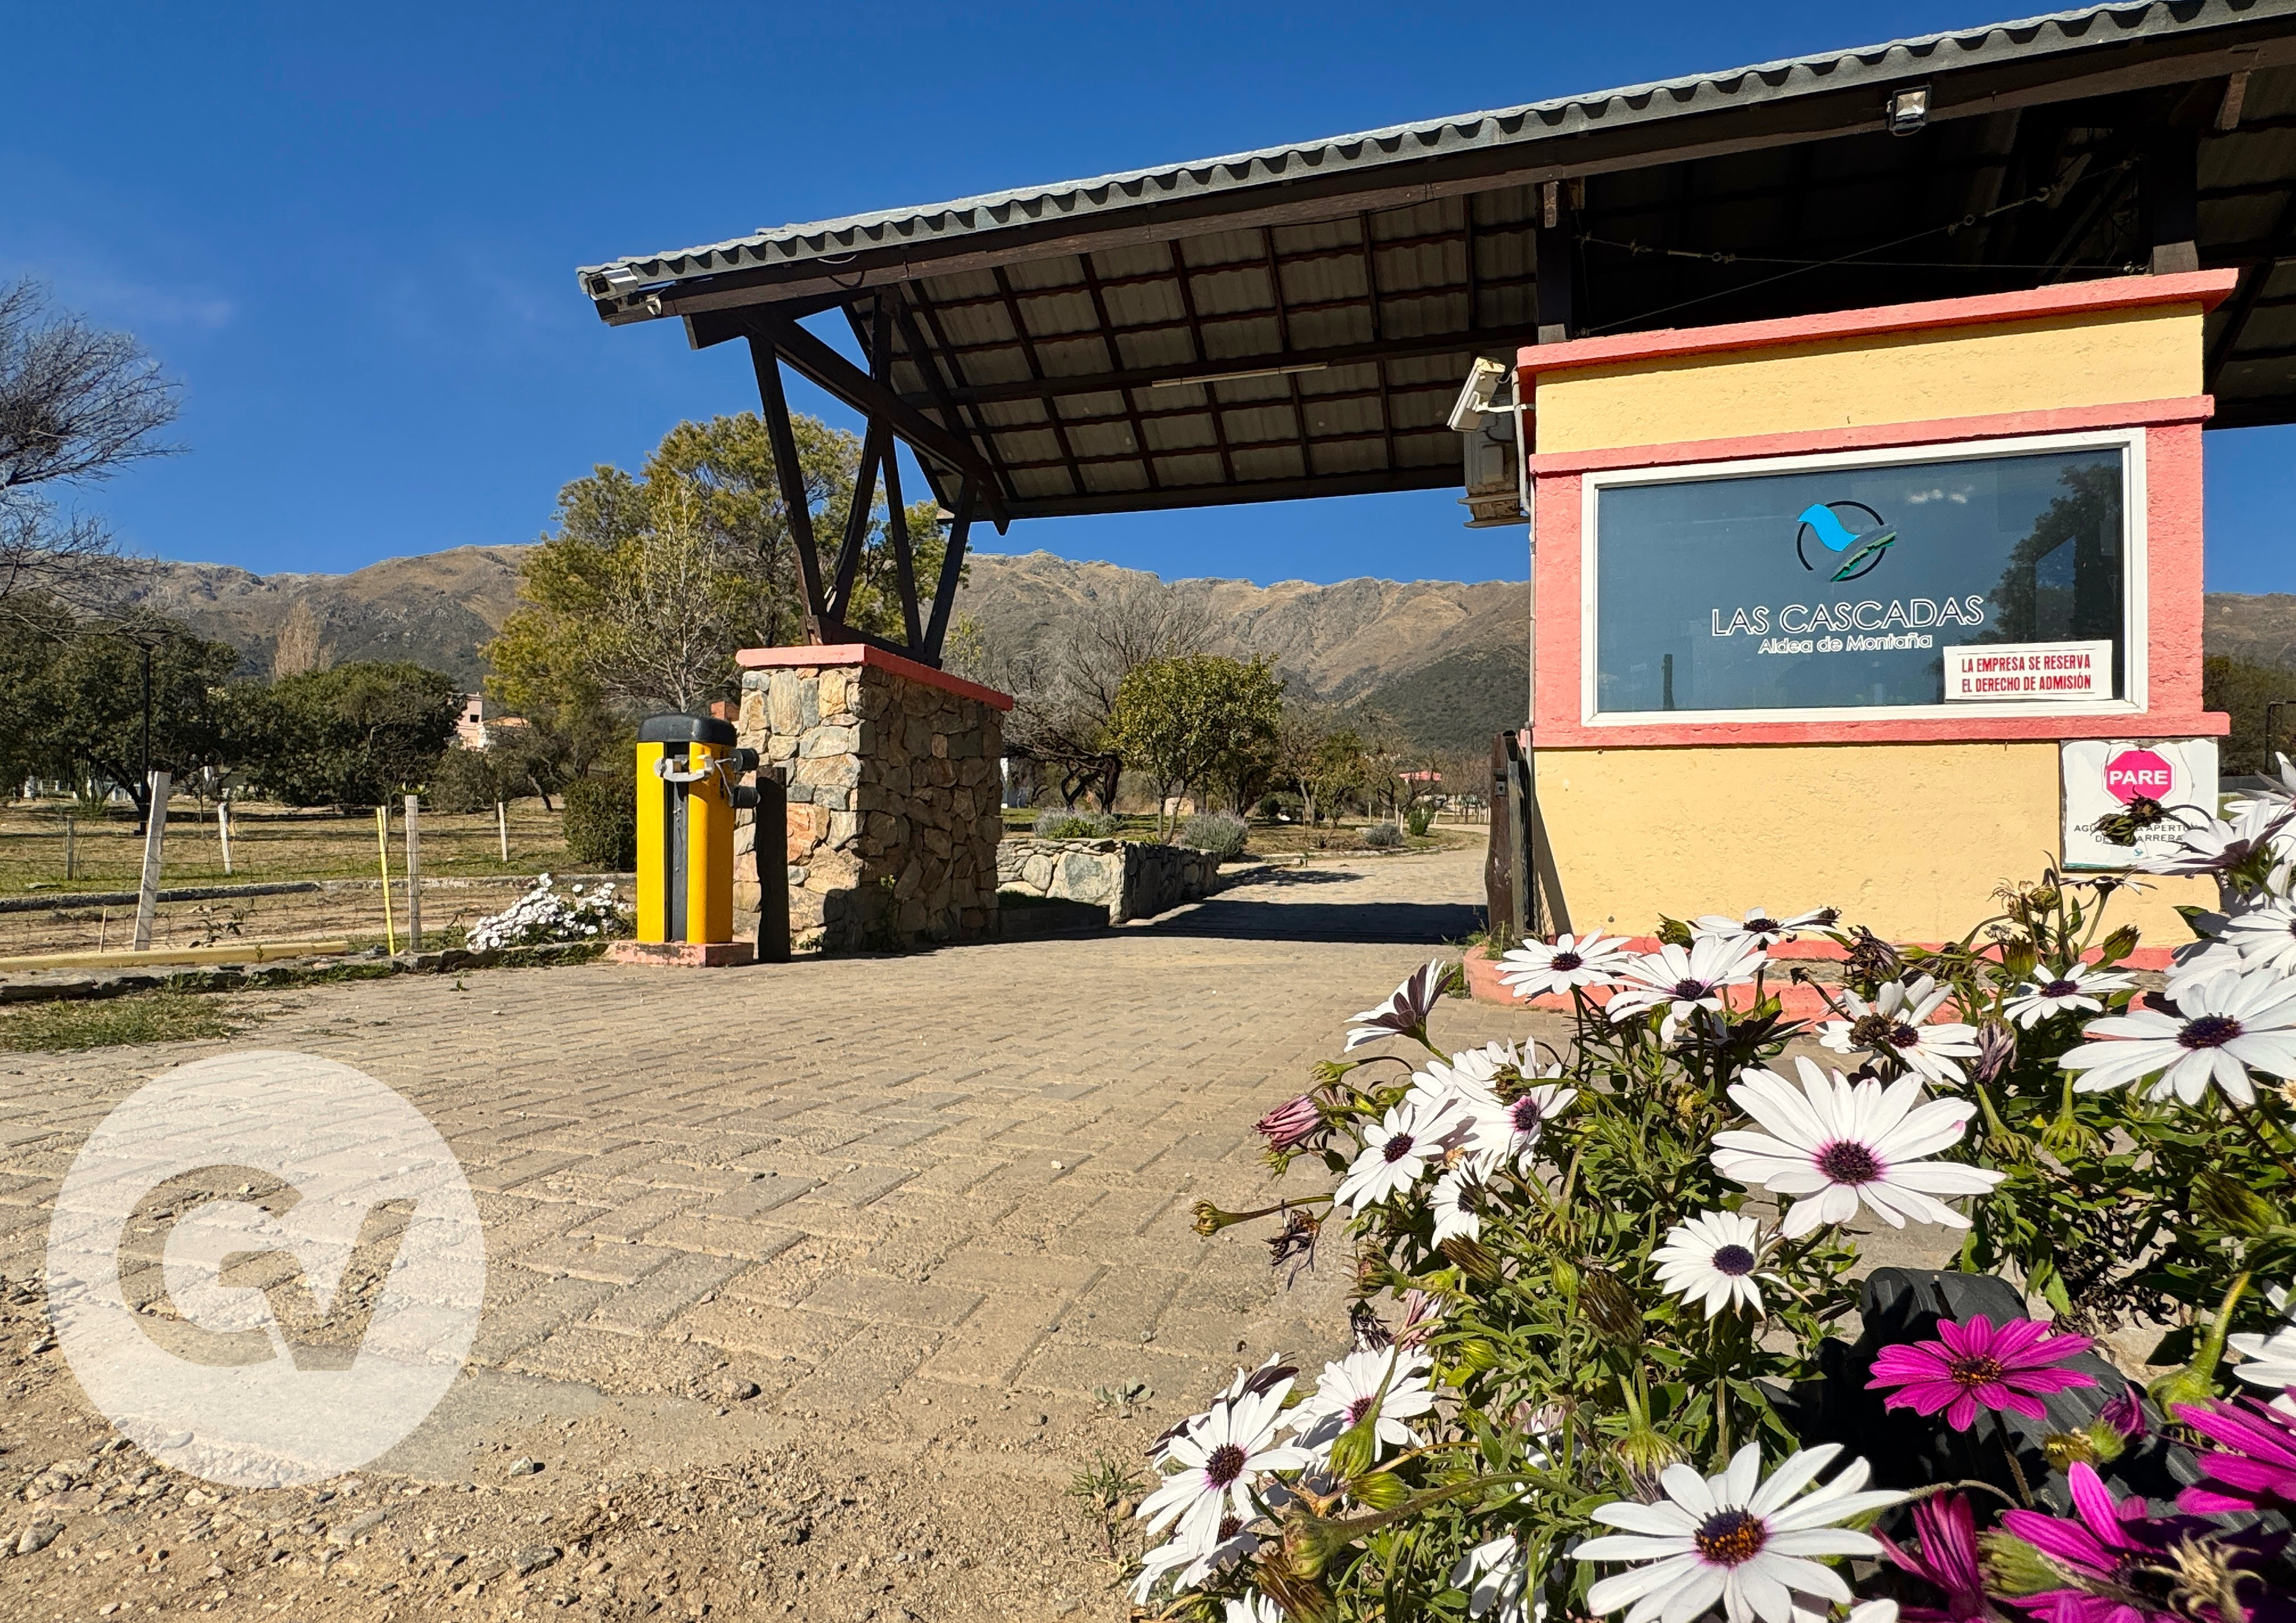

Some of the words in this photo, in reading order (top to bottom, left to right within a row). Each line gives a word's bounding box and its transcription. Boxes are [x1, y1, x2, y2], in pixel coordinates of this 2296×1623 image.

[1712, 607, 1769, 636] LAS
[1780, 595, 1984, 633] CASCADAS
[1758, 637, 1813, 654] Aldea
[1817, 636, 1843, 652] de
[1846, 633, 1933, 651] Montaña
[1962, 658, 1974, 673] LA
[1977, 656, 2025, 673] EMPRESA
[2028, 655, 2040, 671] SE
[2044, 654, 2090, 670] RESERVA
[1962, 678, 1972, 692] EL
[1976, 677, 2020, 692] DERECHO
[2023, 676, 2036, 691] DE
[2039, 671, 2091, 690] ADMISIÓN
[2109, 770, 2168, 785] PARE
